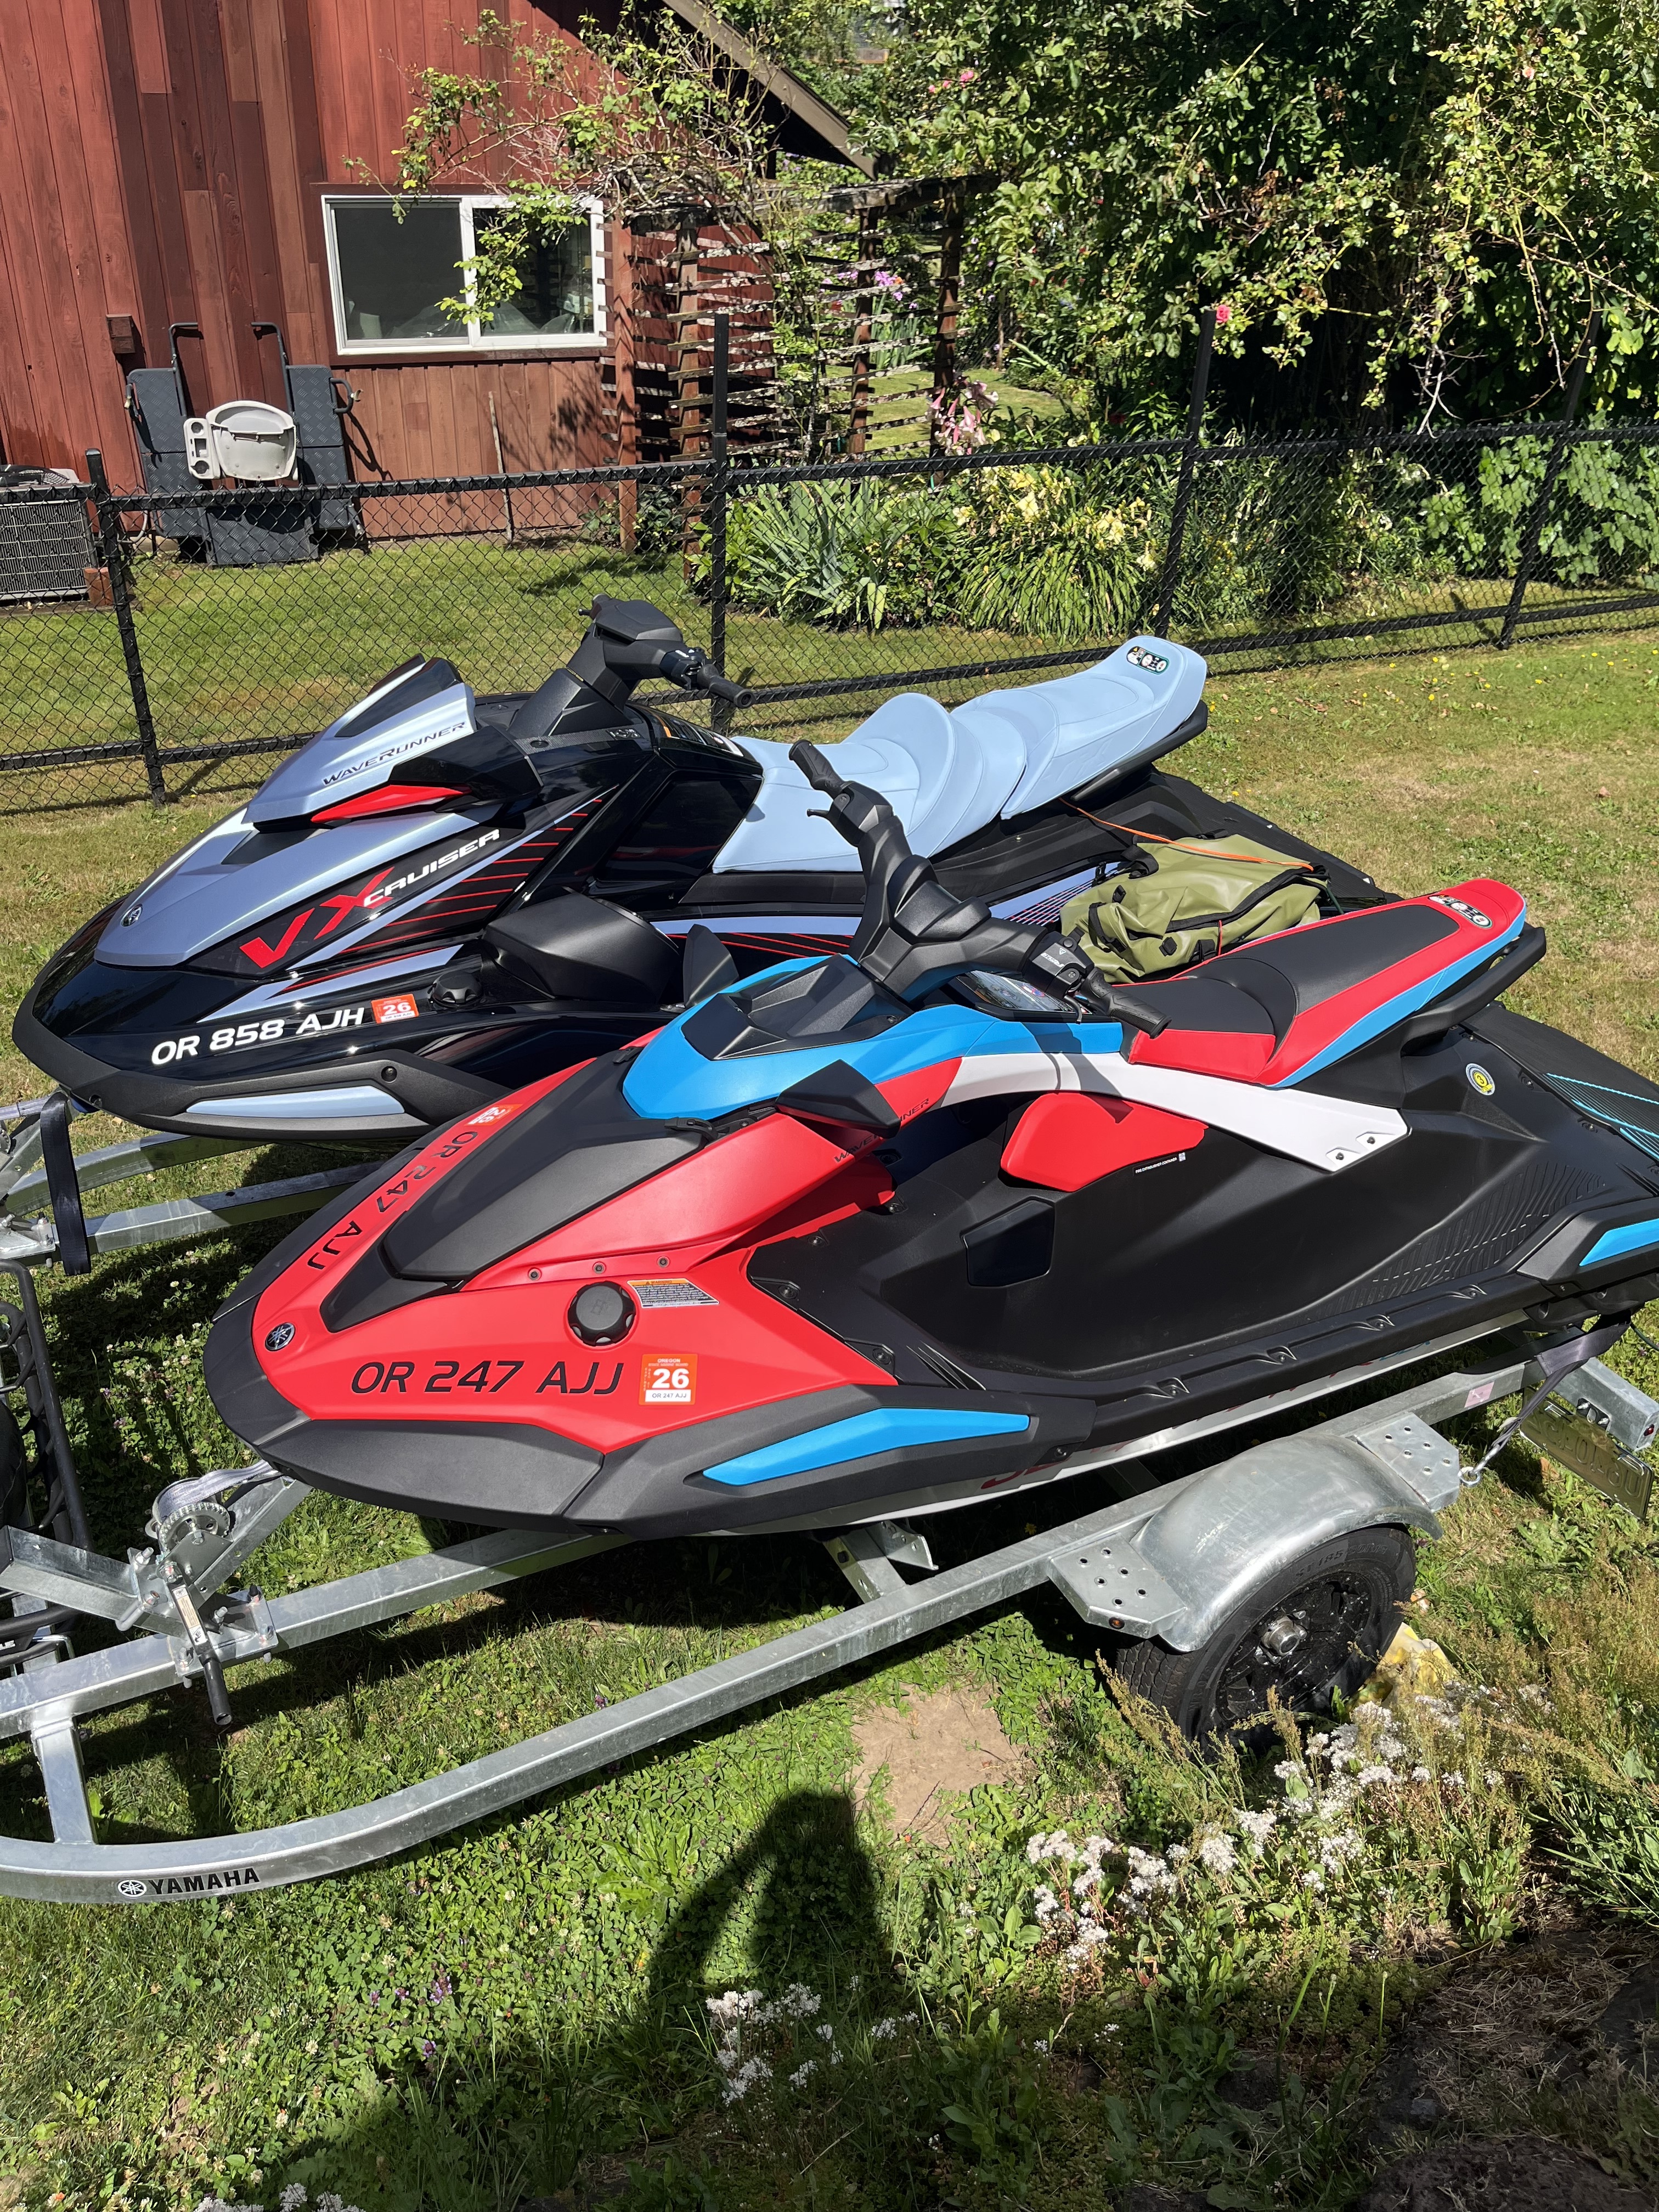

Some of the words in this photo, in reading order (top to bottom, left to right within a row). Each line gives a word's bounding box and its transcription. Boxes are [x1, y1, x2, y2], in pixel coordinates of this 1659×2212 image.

[363, 829, 500, 907] CRUISER
[239, 866, 394, 969] VX
[383, 1002, 411, 1015] 26
[151, 1035, 201, 1065] OR
[210, 1019, 286, 1052] 858
[296, 1007, 365, 1035] AJH
[431, 1131, 478, 1158] OR
[376, 1164, 437, 1213] 247
[307, 1220, 363, 1270] AJJ
[351, 1361, 415, 1393] OR
[424, 1360, 525, 1392] 247
[534, 1361, 624, 1395] AJJ
[652, 1368, 690, 1389] 26
[148, 1867, 260, 1895] YAMAHA
